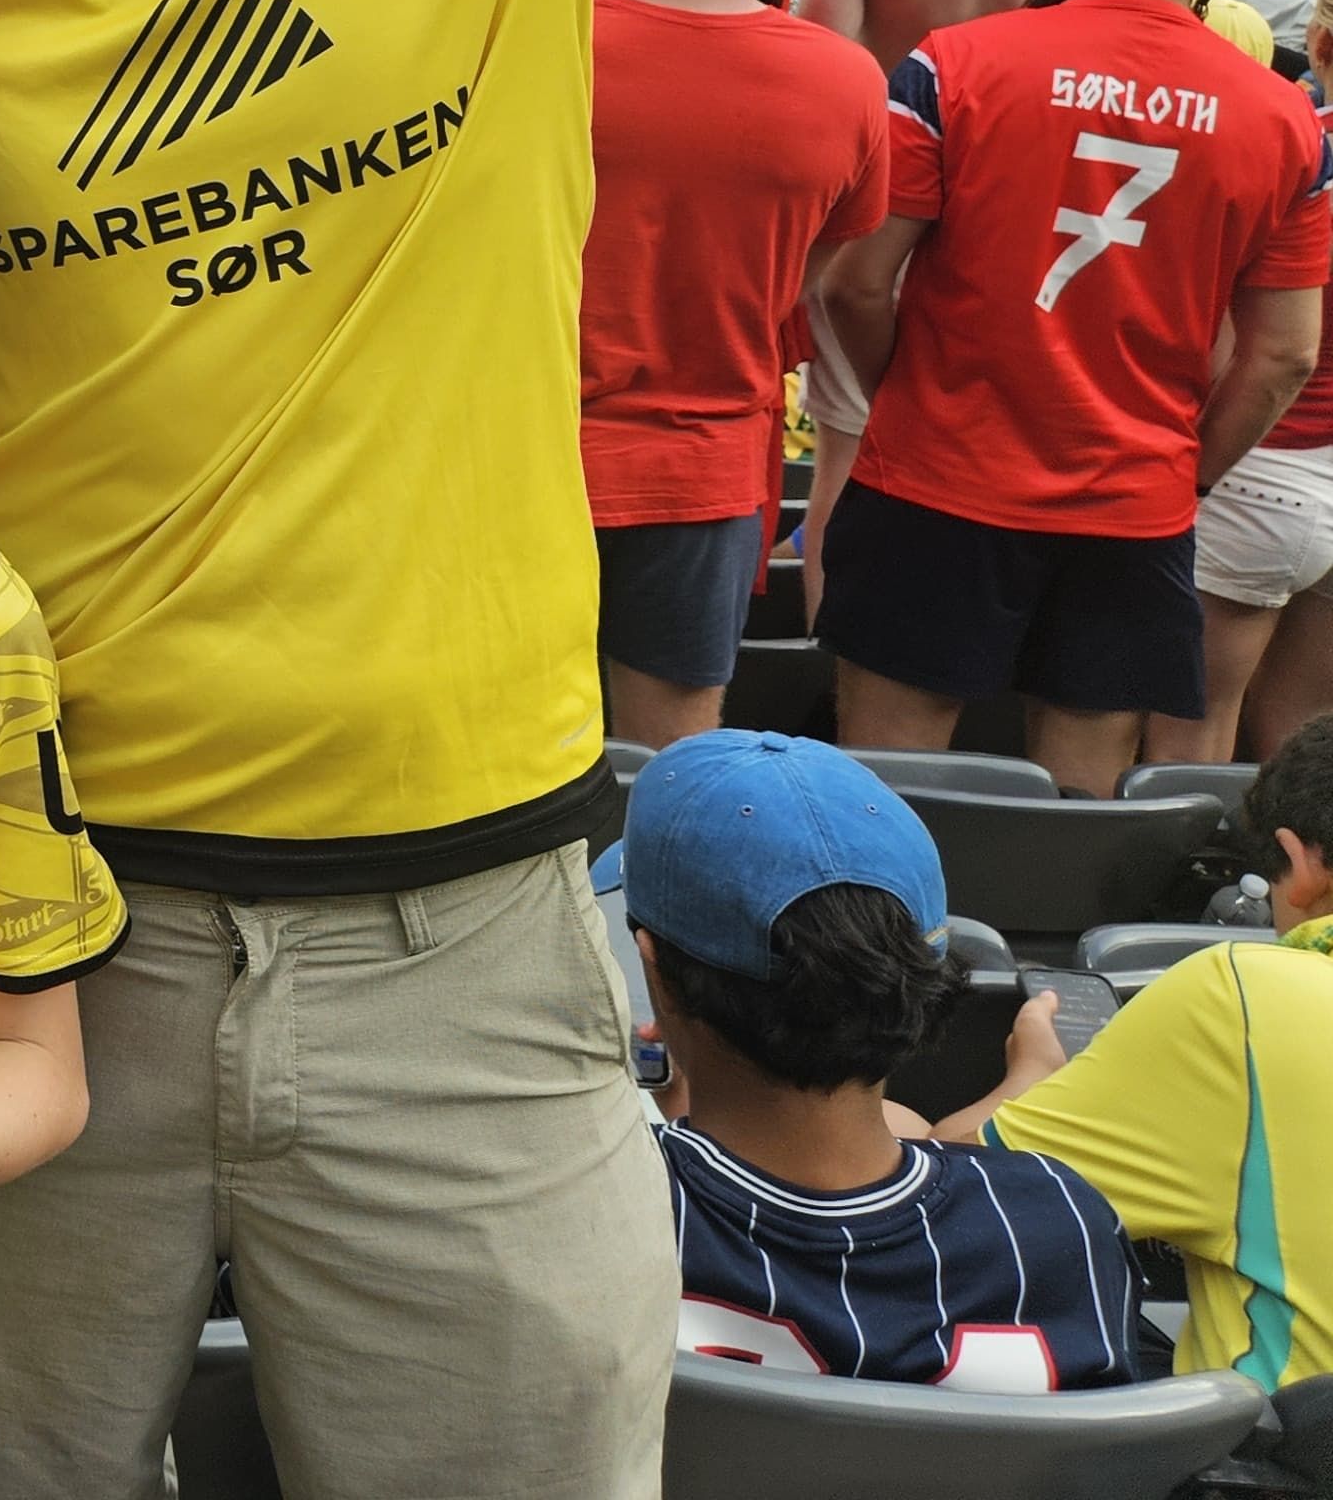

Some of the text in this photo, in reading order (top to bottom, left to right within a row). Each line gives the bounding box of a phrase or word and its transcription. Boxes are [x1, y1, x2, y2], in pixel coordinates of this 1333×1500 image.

[1051, 68, 1219, 135] SØRLOTH
[1034, 131, 1180, 313] 7
[168, 229, 311, 308] SØR
